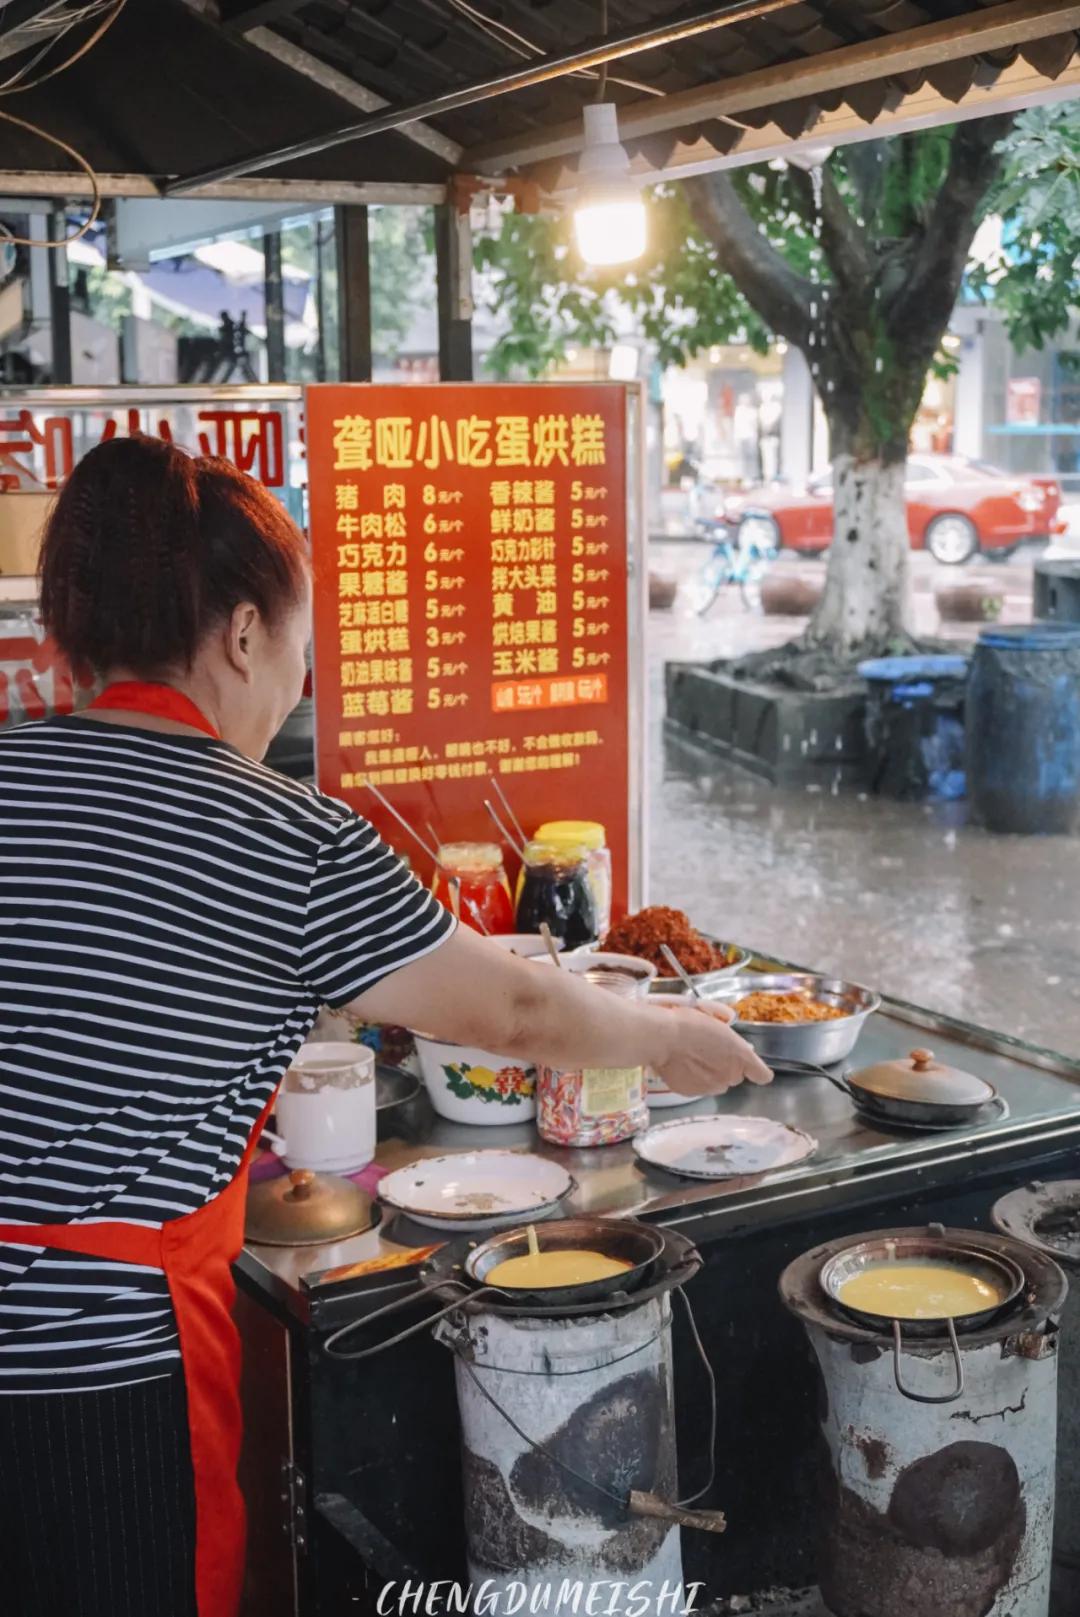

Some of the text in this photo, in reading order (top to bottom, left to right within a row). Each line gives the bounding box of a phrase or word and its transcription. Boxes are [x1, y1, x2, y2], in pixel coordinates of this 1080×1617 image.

[332, 414, 606, 471] 聋哑小吃蛋烘糕
[490, 480, 556, 506] 香辣酱
[336, 513, 407, 539] 牛肉松
[490, 508, 556, 534] 鲜奶酱
[337, 541, 407, 569] 巧克力
[491, 537, 556, 563] 巧克力彩针
[340, 626, 410, 655] 蛋烘糕
[492, 647, 559, 675] 玉米酱
[342, 688, 414, 718] 蓝莓酱
